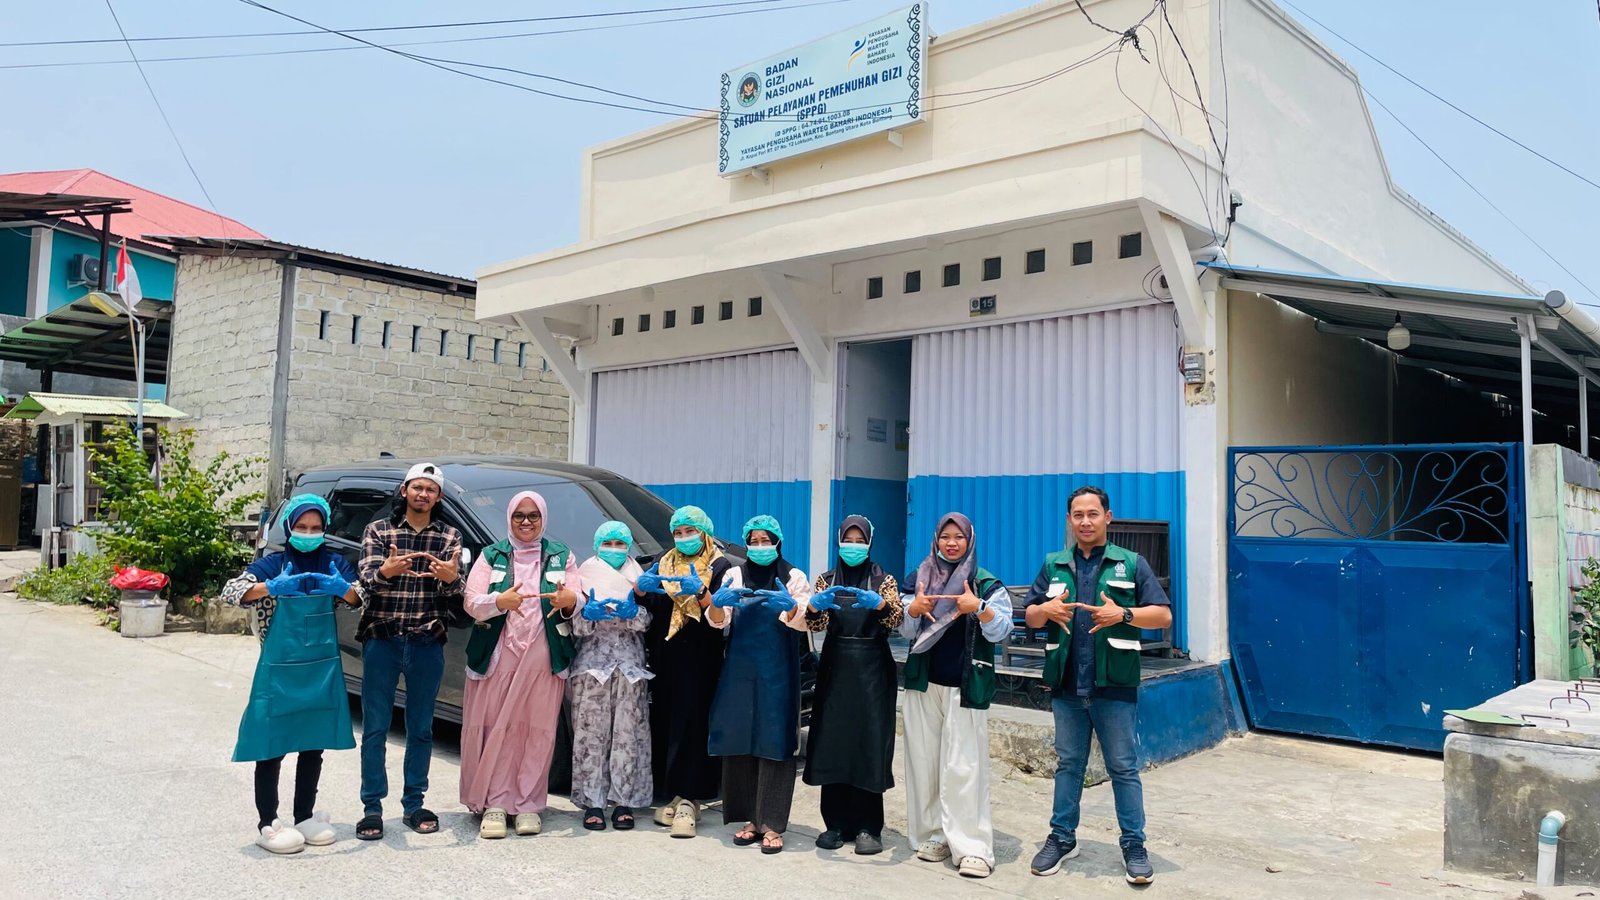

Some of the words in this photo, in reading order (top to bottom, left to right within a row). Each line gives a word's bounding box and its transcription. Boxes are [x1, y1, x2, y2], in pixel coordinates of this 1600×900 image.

[867, 30, 899, 45] PENGUSAHA
[868, 26, 891, 38] YAYASAN
[867, 40, 889, 52] WARTEG
[866, 52, 896, 66] INDONESIA
[867, 48, 887, 59] BAHARI
[765, 57, 799, 77] BADAN
[765, 74, 785, 88] GIZI
[765, 77, 814, 101] NASIONAL
[734, 110, 765, 129] SATUAN
[768, 92, 816, 118] PELAYANAN
[818, 73, 878, 101] PEMENUHAN
[881, 65, 902, 83] GIZI
[797, 103, 827, 122] (SPPG)
[741, 143, 766, 155] YAYASAN
[766, 133, 802, 148] PENGUSAHA
[803, 124, 829, 137] WARTEG
[830, 117, 854, 129] BAHARI
[856, 106, 892, 121] INDONESIA
[782, 126, 797, 135] SPPG
[982, 299, 993, 308] 15
